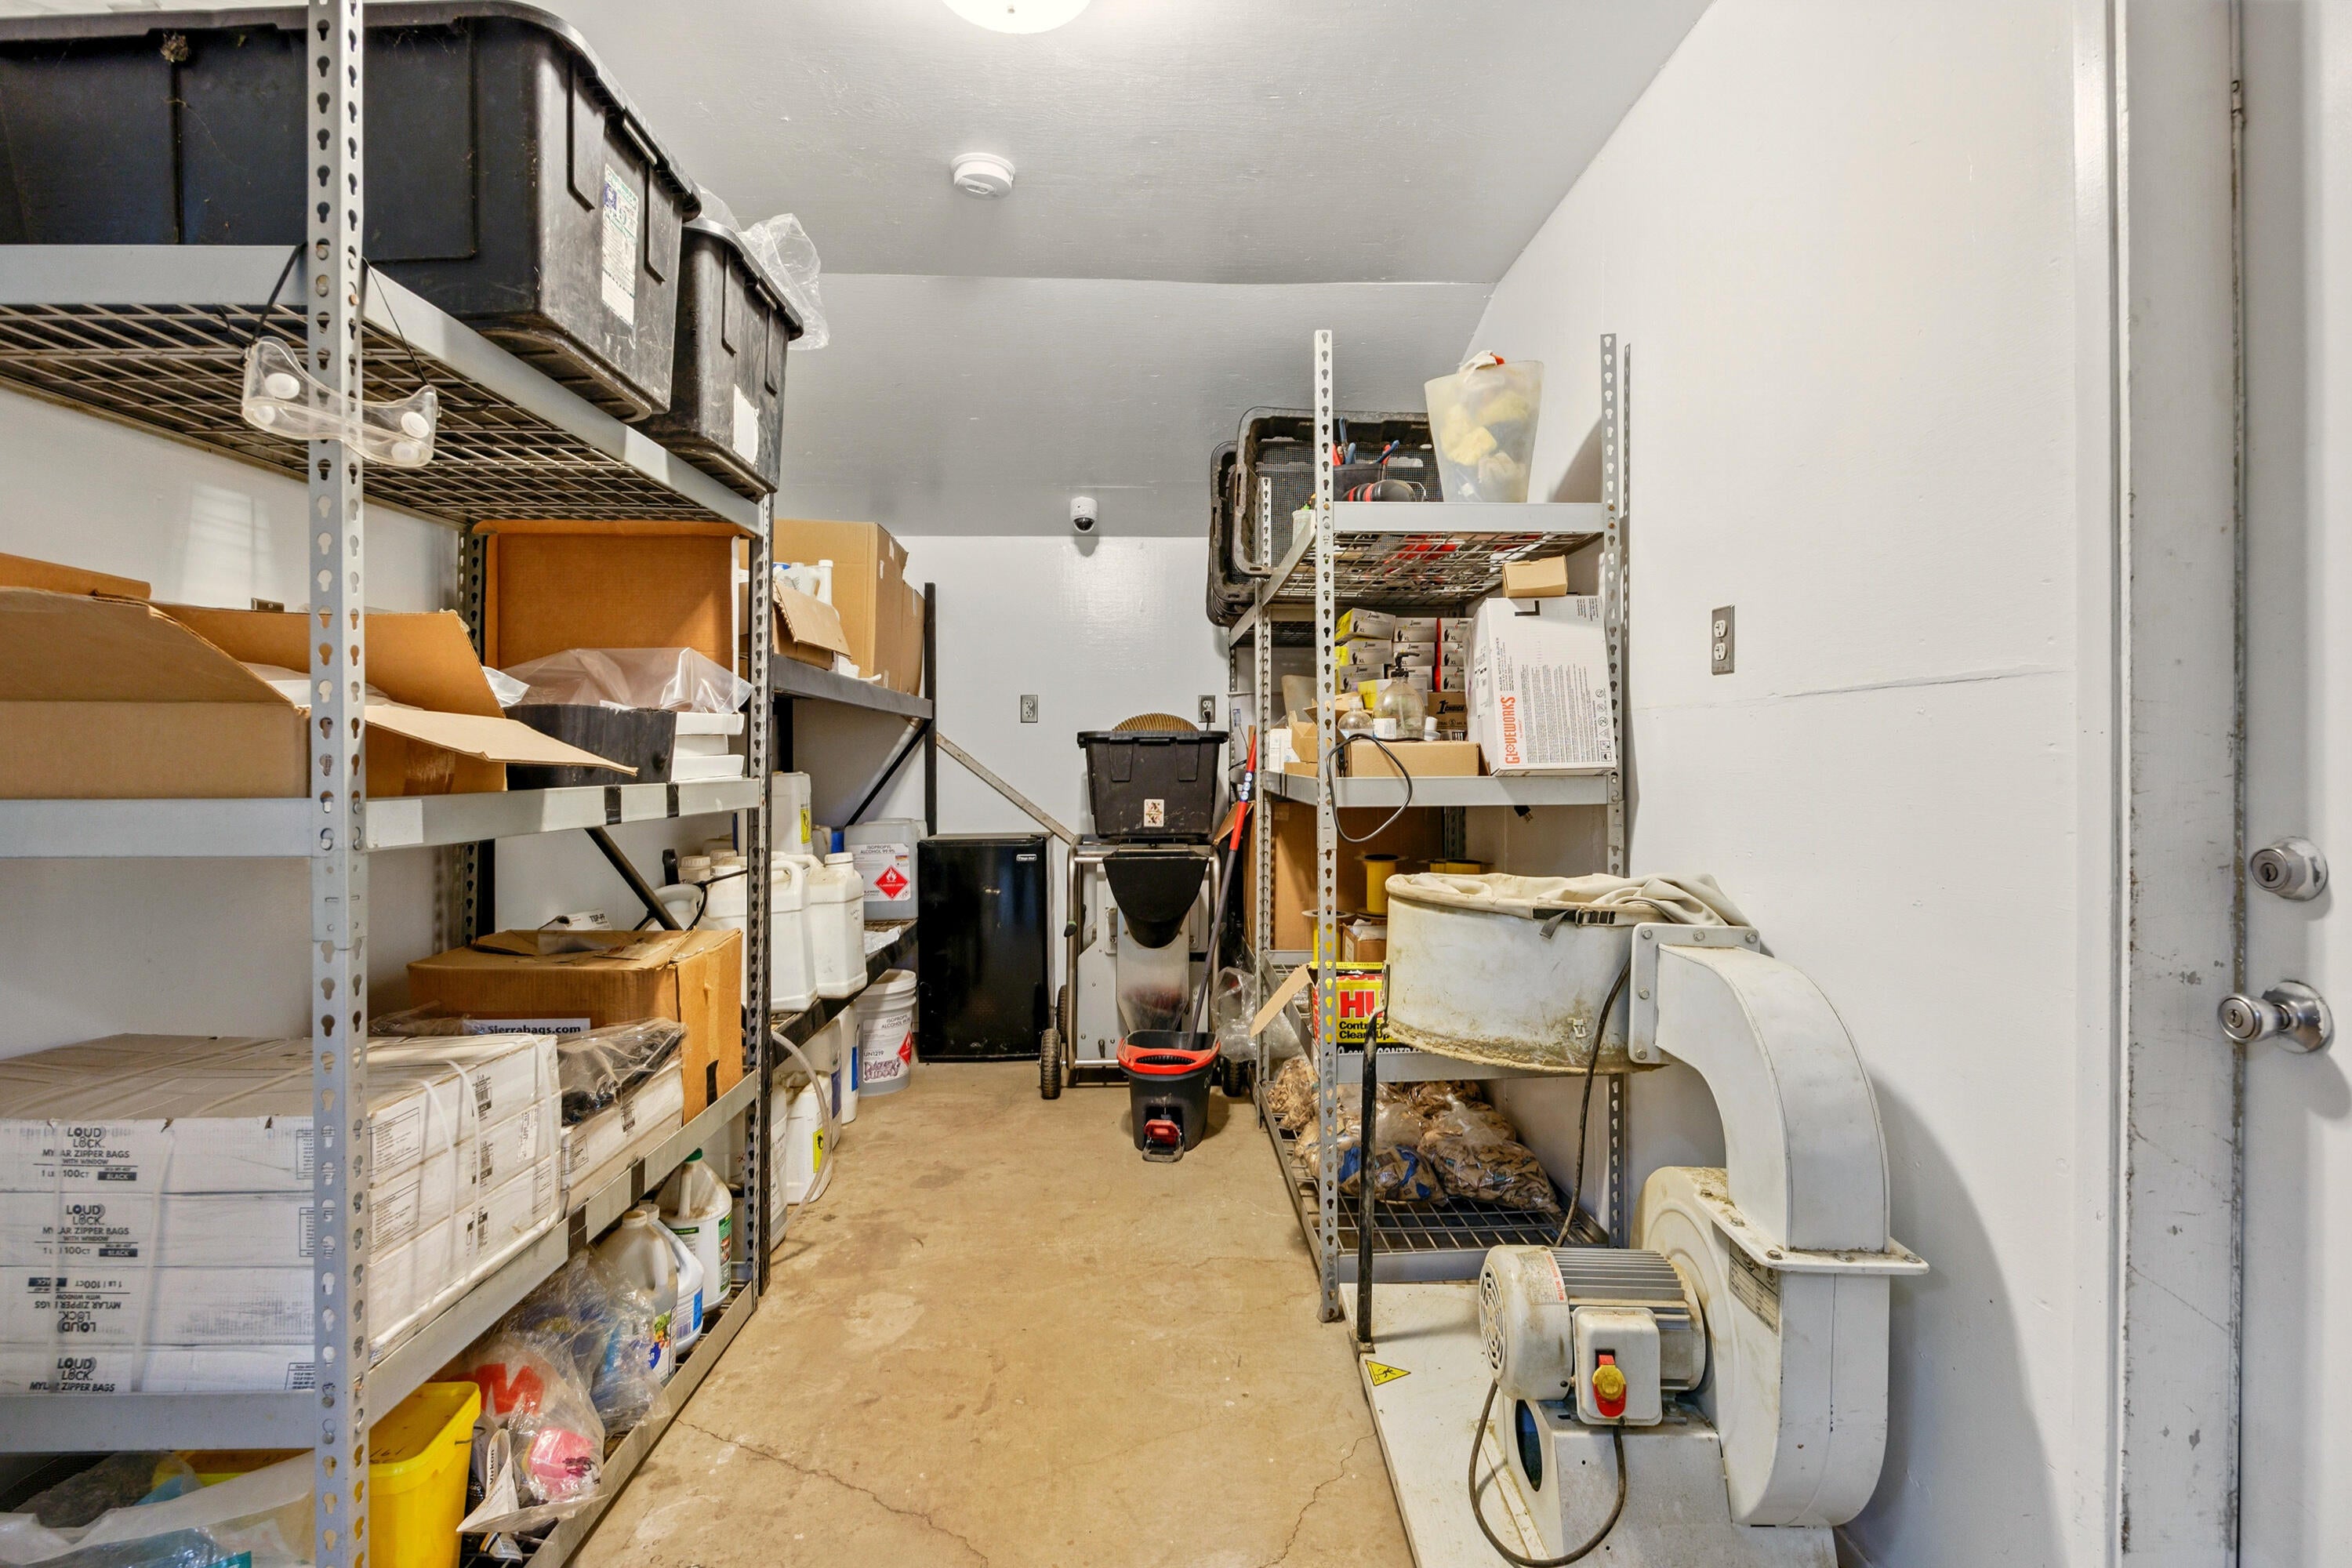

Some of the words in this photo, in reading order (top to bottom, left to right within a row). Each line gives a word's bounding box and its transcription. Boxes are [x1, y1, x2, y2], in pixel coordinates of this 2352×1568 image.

[1515, 600, 1540, 616] L
[1501, 696, 1520, 764] GLOVEWORKS
[488, 1025, 581, 1034] Sierrabags.com
[67, 1127, 103, 1138] LOUD
[73, 1138, 102, 1149] LOCK
[42, 1149, 71, 1158] MYAR
[66, 1204, 103, 1215] LOUD
[73, 1214, 101, 1225] LOCK
[74, 1227, 103, 1236] ZIPPER
[63, 1311, 91, 1323] LOCK
[60, 1322, 96, 1333] LOUD
[57, 1358, 95, 1370] LOUD
[62, 1368, 90, 1381] LOCK
[62, 1383, 90, 1392] ZIPPER
[93, 1383, 115, 1392] BAGS
